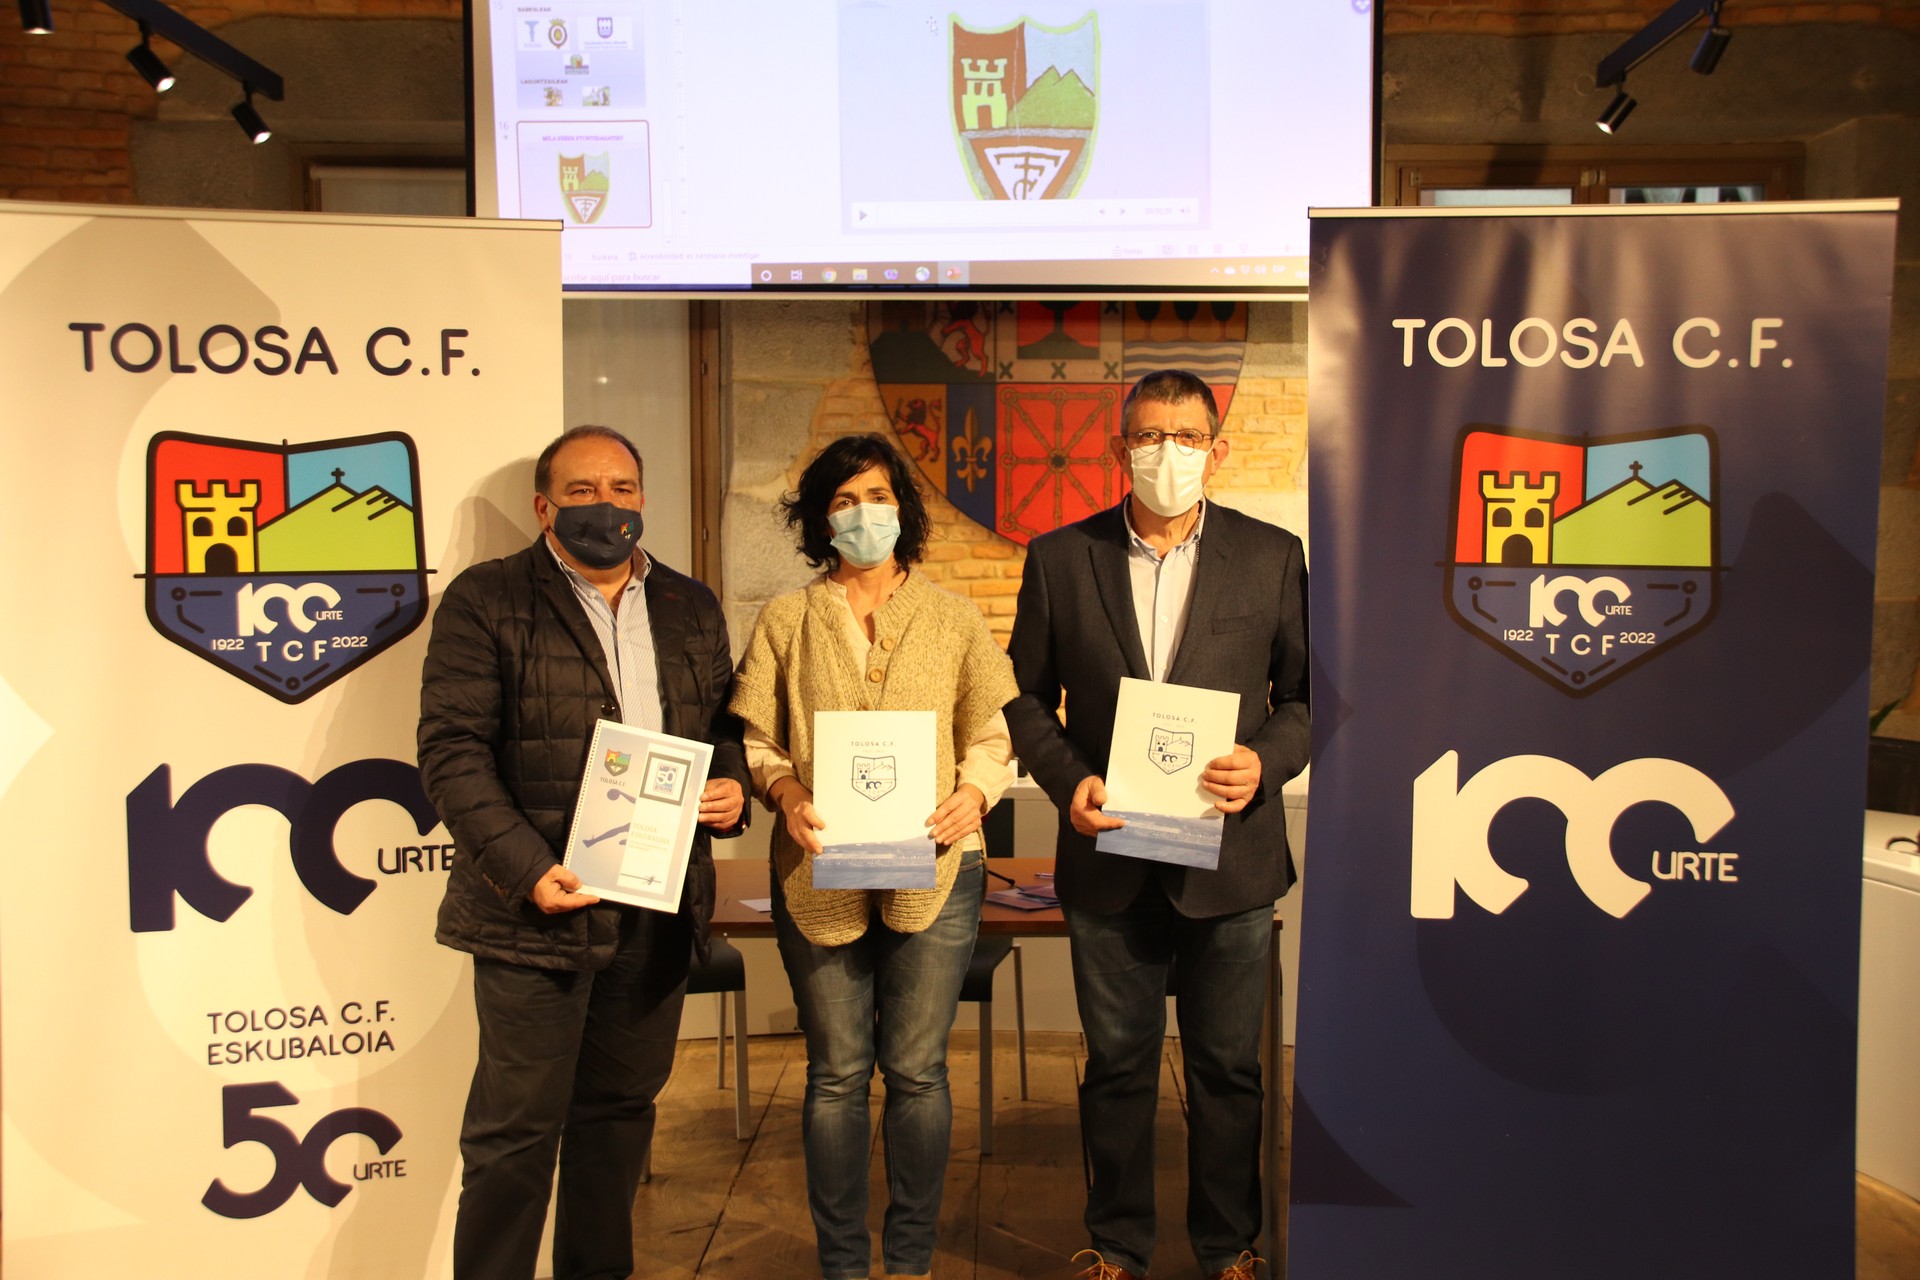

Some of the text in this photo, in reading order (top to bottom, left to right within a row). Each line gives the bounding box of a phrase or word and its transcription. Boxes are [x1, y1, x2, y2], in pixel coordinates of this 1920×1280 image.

[611, 274, 631, 283] para
[633, 272, 661, 282] buscar
[68, 322, 481, 376] TOLOSA C.F.
[1392, 317, 1793, 368] TOLOSA C.F.
[315, 610, 344, 621] URTE
[1605, 605, 1633, 616] URTE
[212, 638, 245, 651] 1922
[331, 635, 369, 648] 2022
[1503, 629, 1534, 642] 1922
[1619, 631, 1656, 645] 2022
[1152, 712, 1180, 721] TOLOSA
[600, 776, 619, 785] TOLOSA
[377, 843, 456, 875] URTE
[1651, 850, 1739, 883] URTE
[207, 1000, 396, 1035] TOLOSA C.F.
[208, 1030, 396, 1066] ESKUBALOIA
[201, 1080, 407, 1220] 50 URTE
